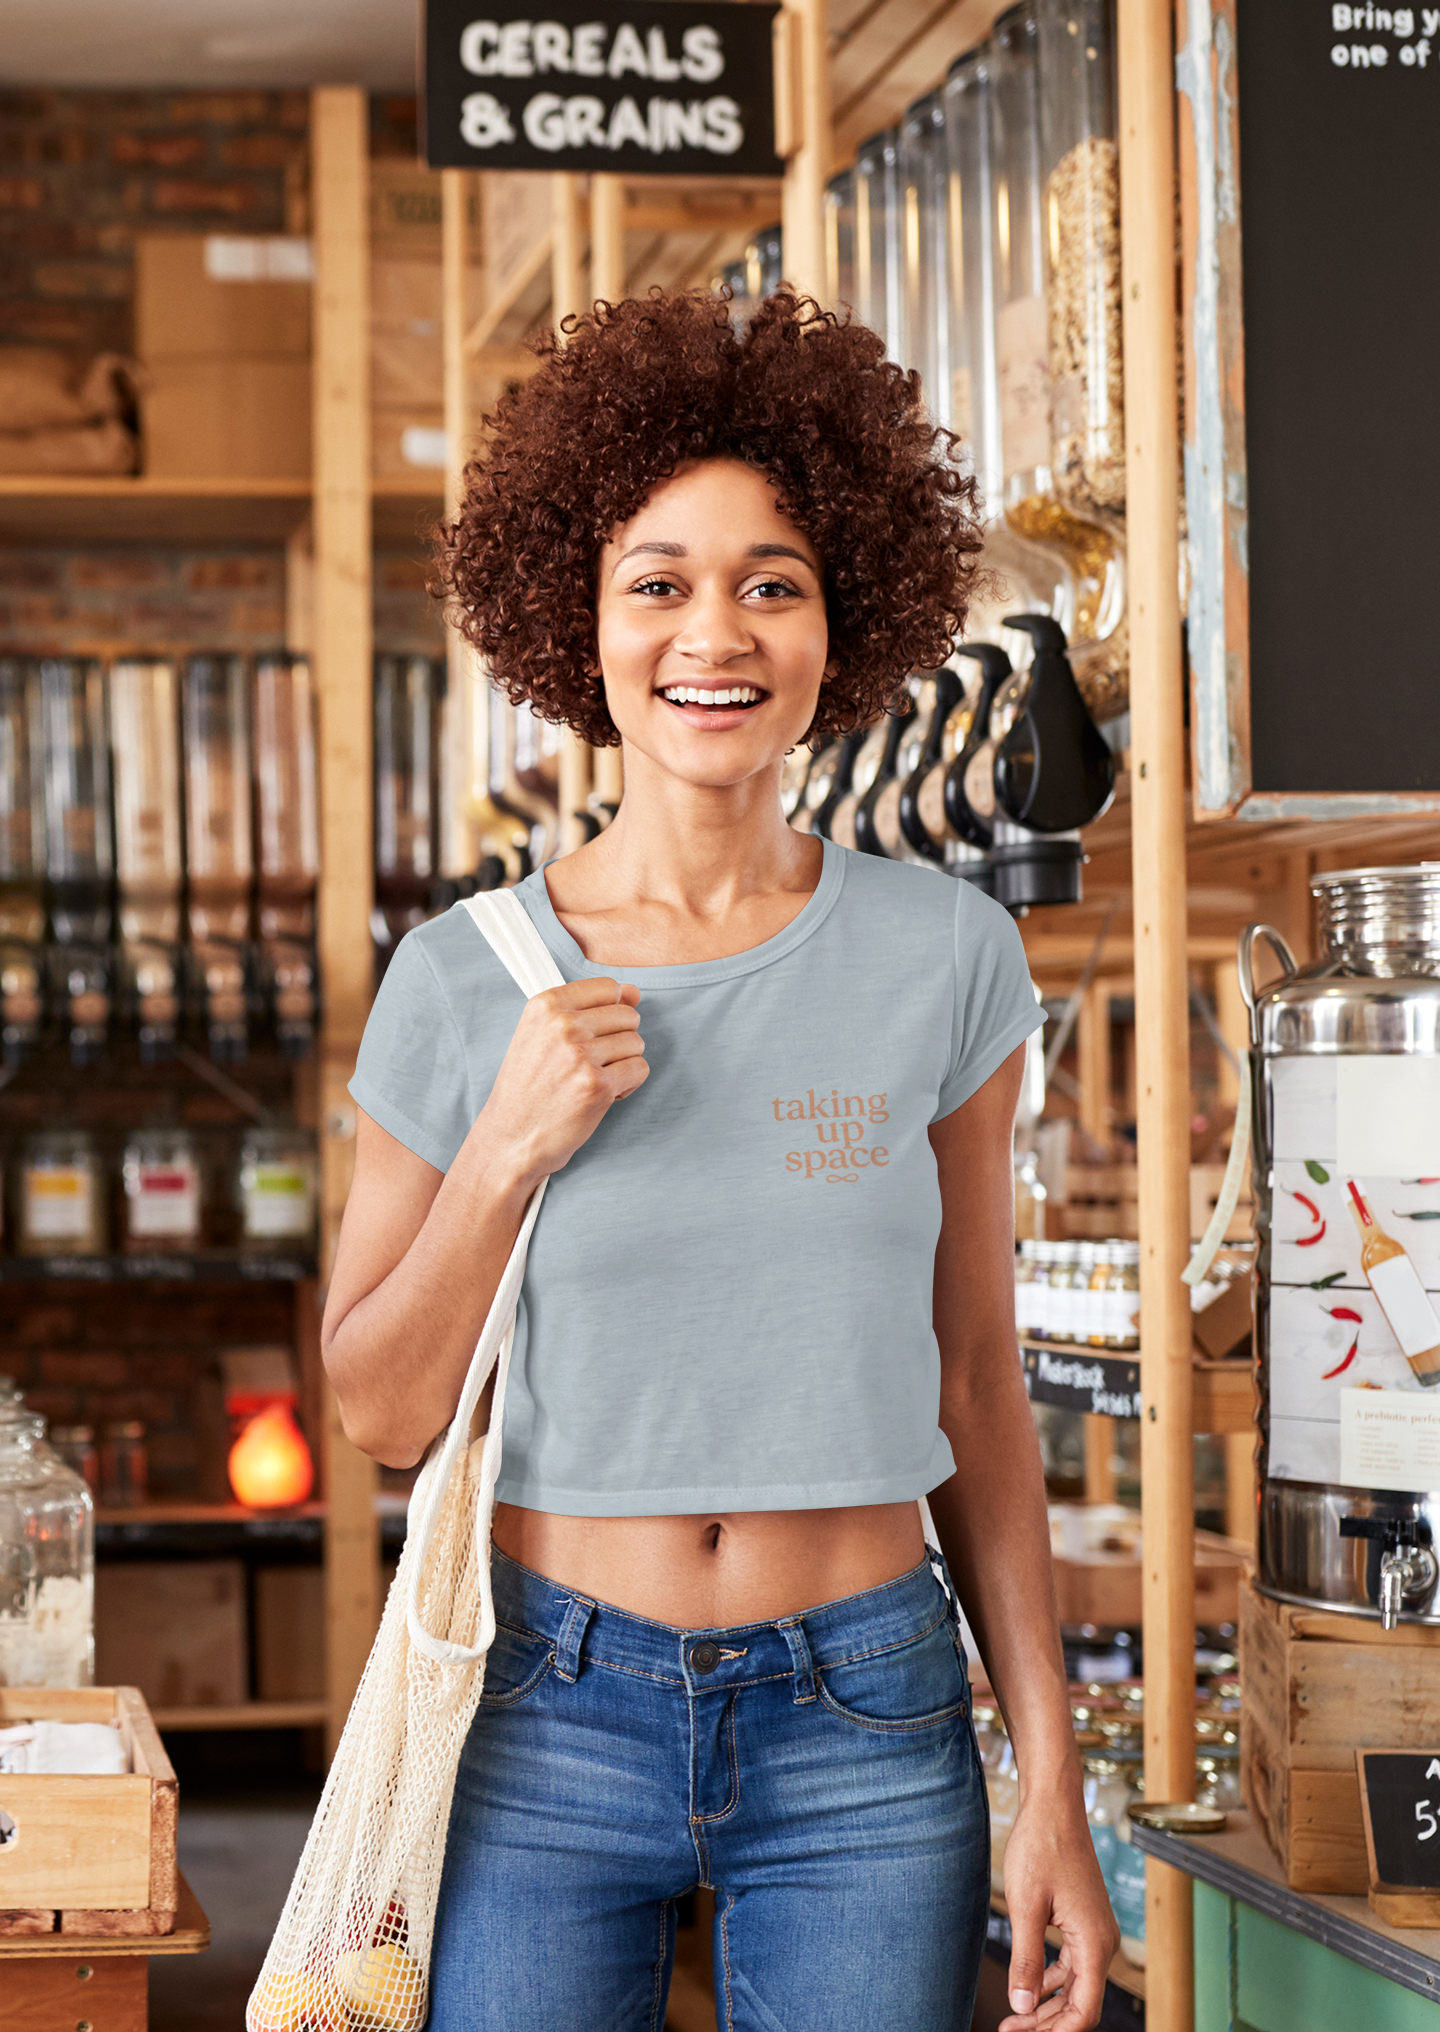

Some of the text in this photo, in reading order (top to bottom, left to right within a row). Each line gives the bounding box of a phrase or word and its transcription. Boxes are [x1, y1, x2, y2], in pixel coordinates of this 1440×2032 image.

[1332, 0, 1440, 38] Bring y
[460, 20, 724, 82] CEREALS
[1330, 38, 1431, 68] one of
[460, 92, 744, 154] & GRAINS
[772, 1089, 889, 1124] taking
[815, 1121, 864, 1149] up
[786, 1146, 889, 1178] space
[1415, 1799, 1440, 1841] 5
